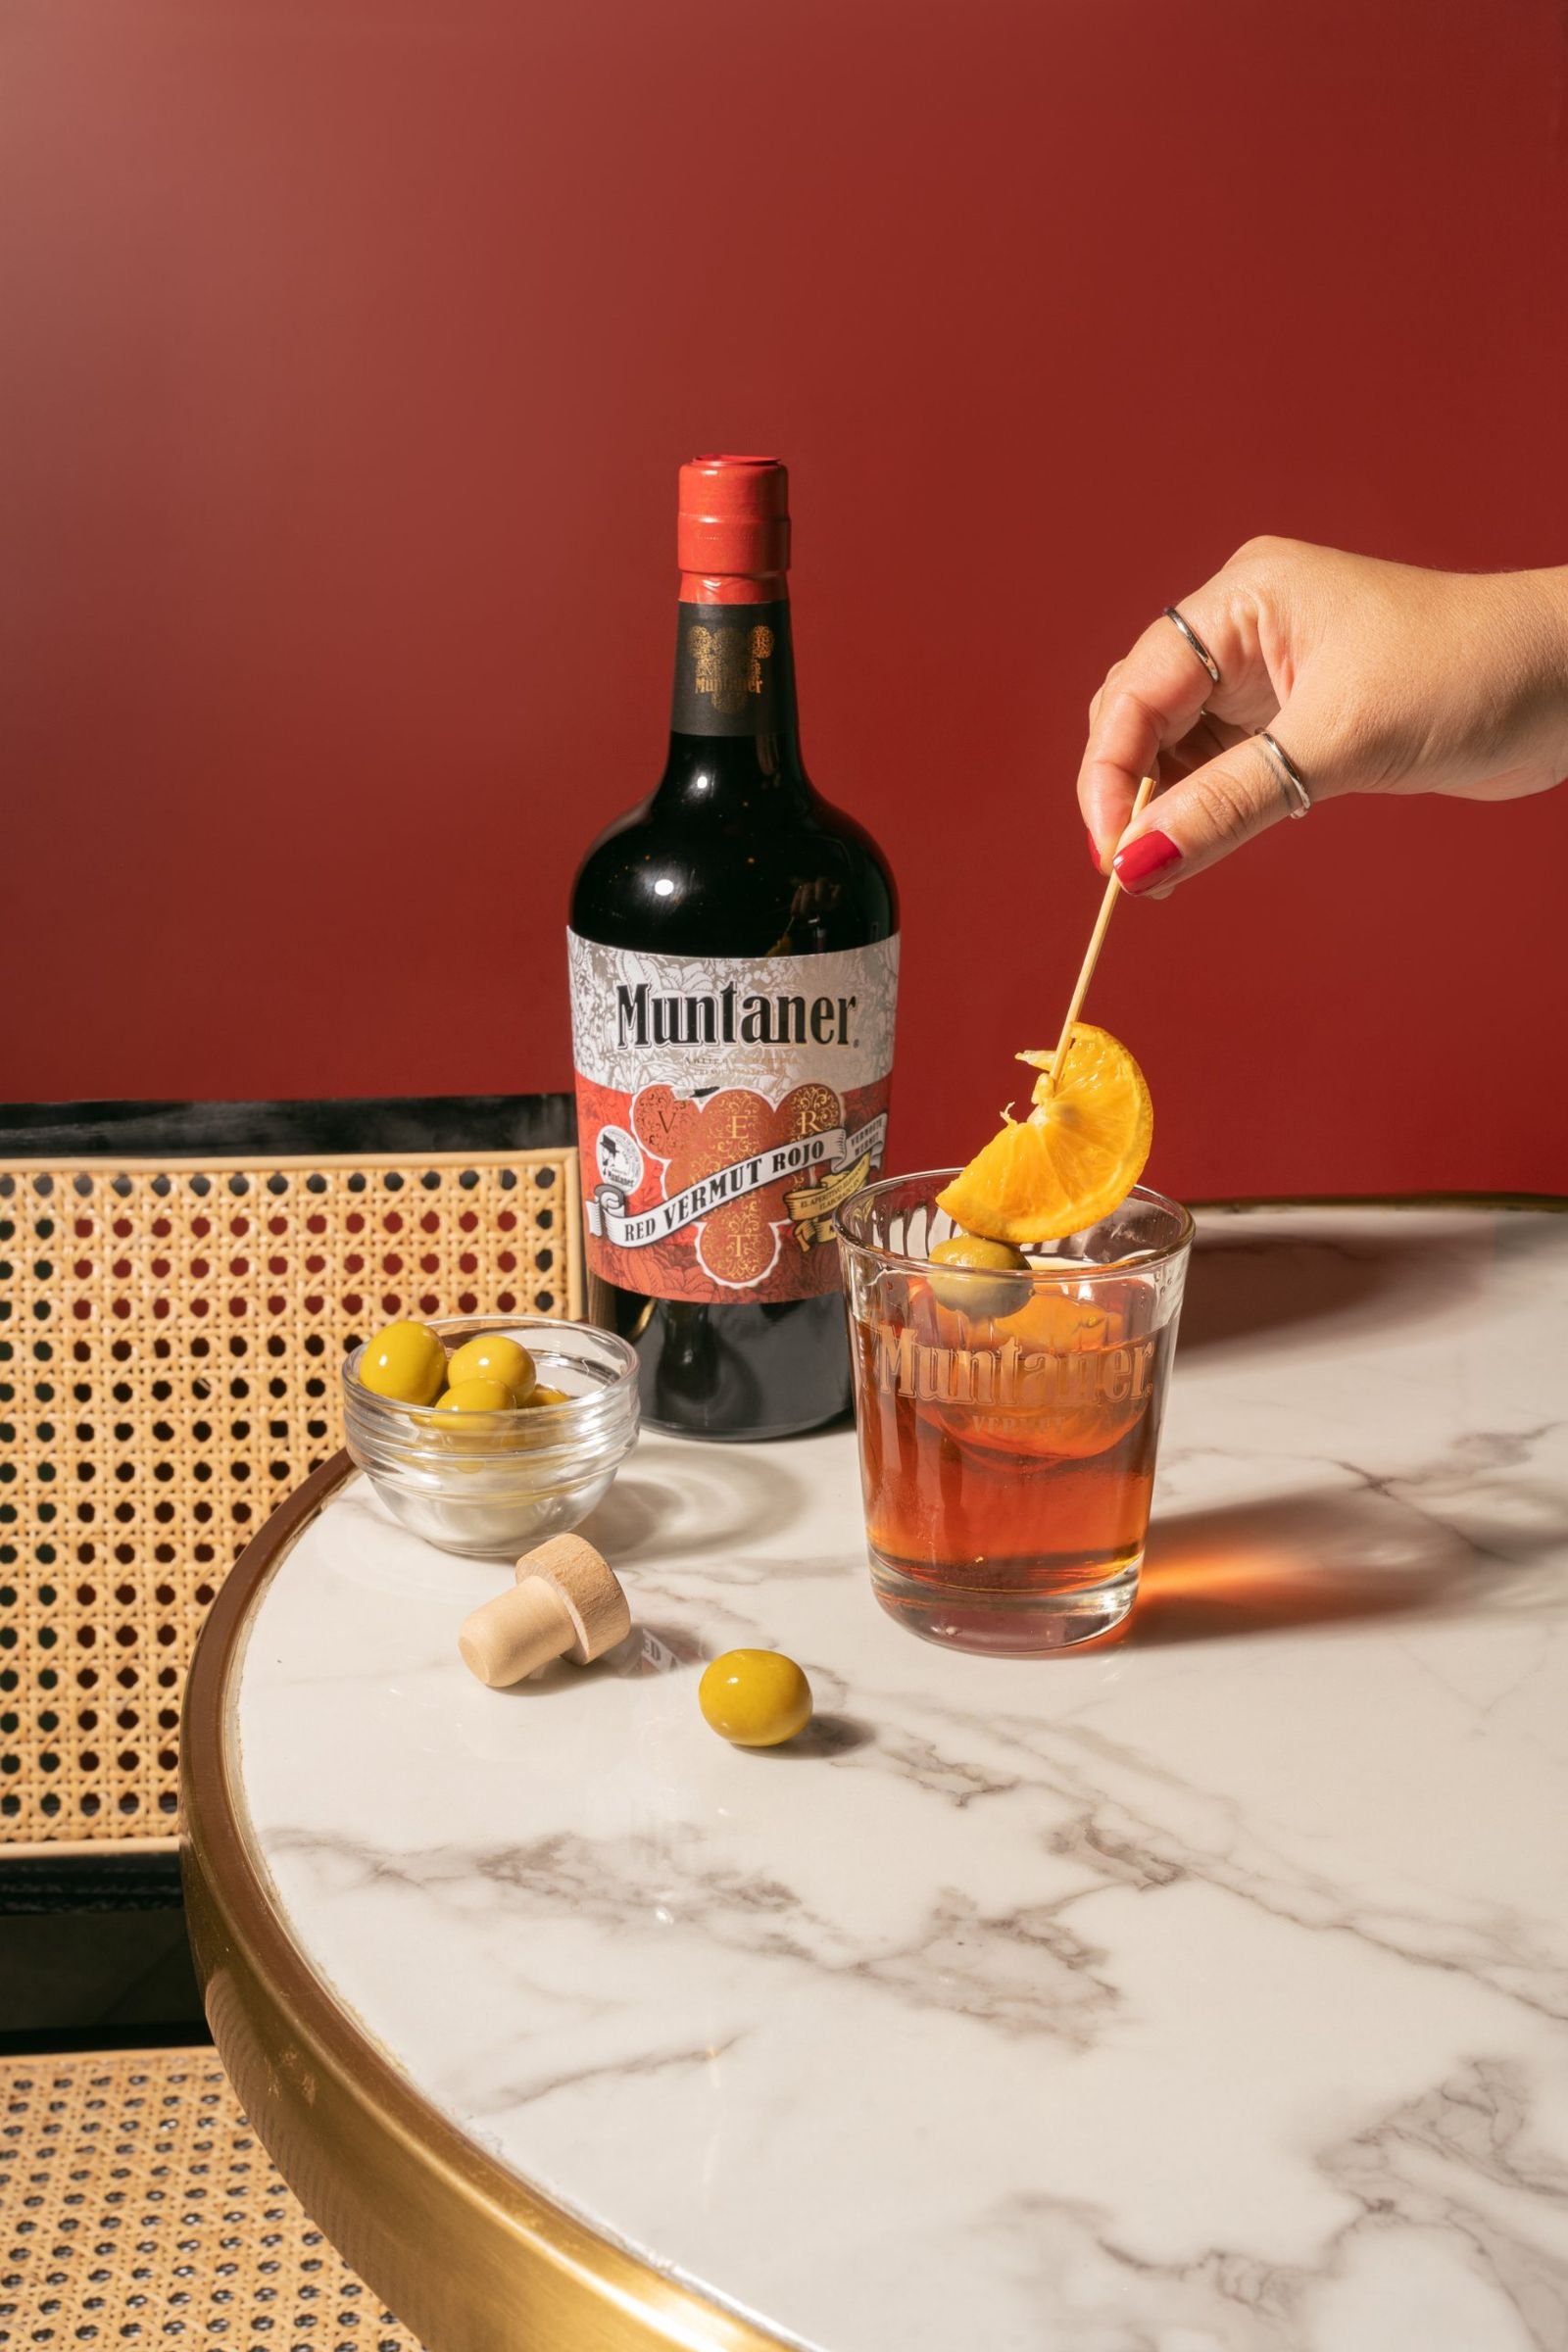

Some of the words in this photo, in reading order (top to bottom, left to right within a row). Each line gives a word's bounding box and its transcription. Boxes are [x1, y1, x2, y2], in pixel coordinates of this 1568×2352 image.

[616, 981, 858, 1048] Muntaner
[624, 1217, 656, 1242] RED
[663, 1157, 762, 1230] VERMUT
[772, 1140, 824, 1174] ROJO
[879, 1325, 1154, 1406] Muntaner
